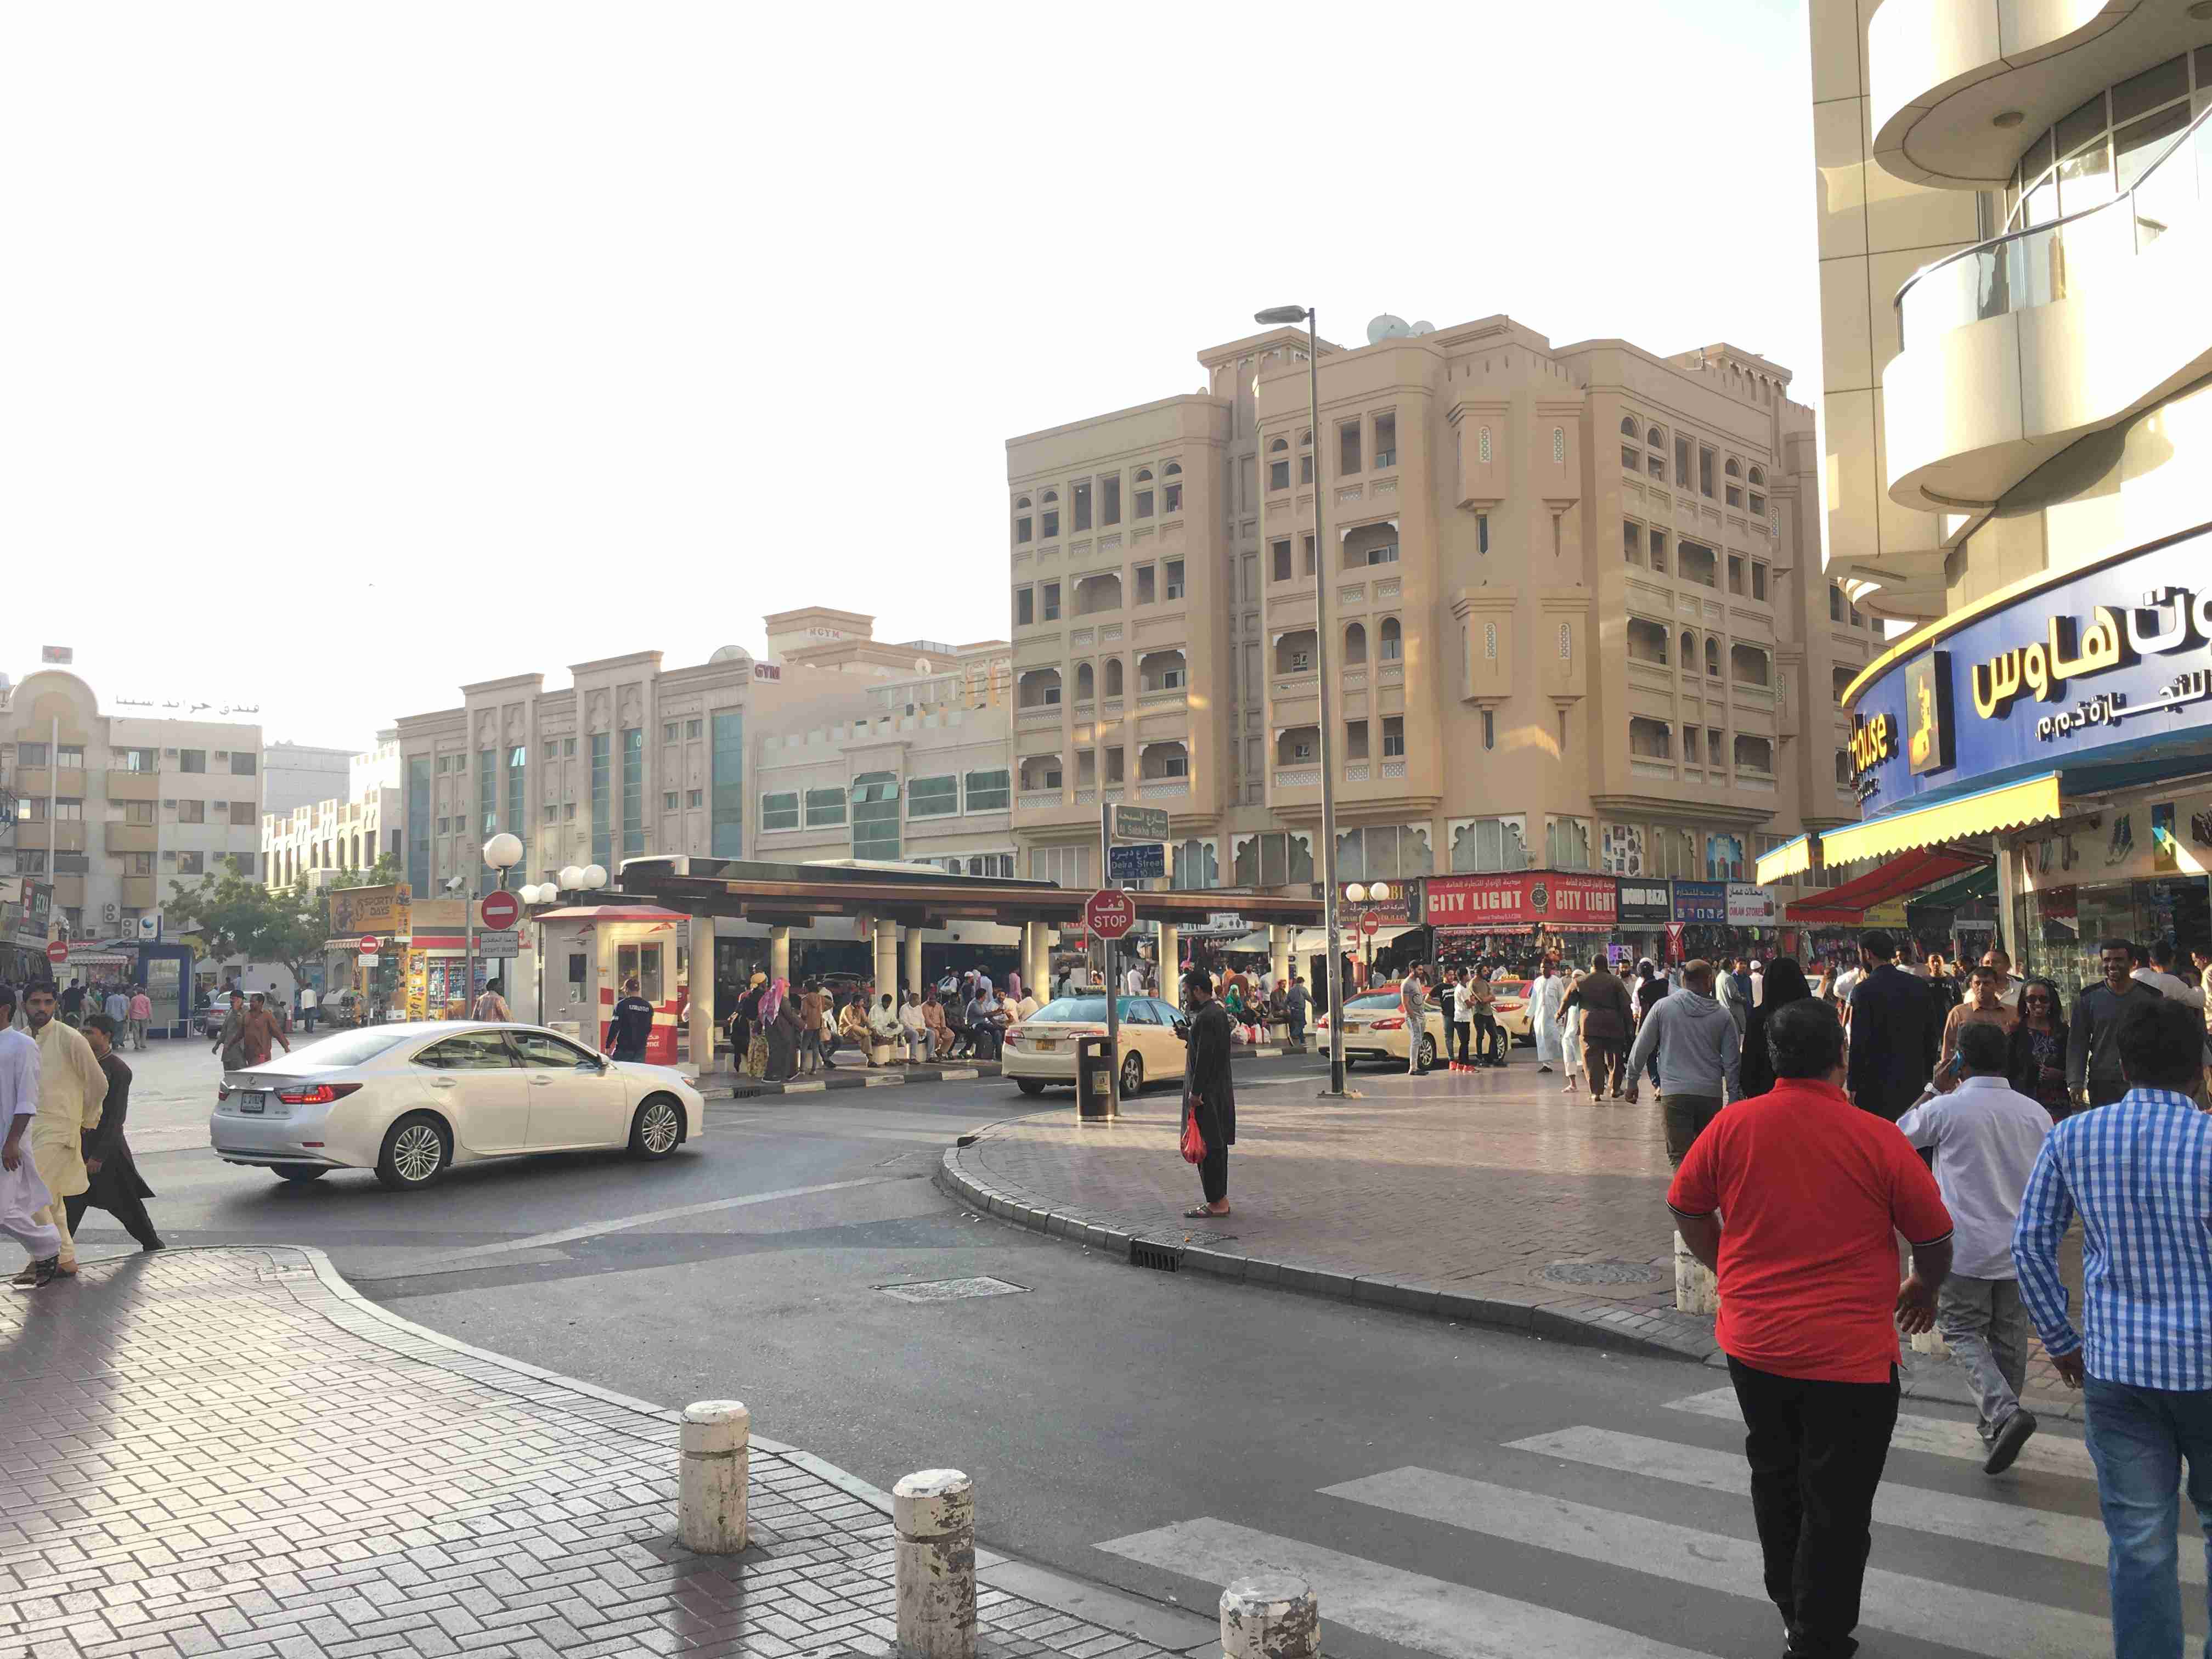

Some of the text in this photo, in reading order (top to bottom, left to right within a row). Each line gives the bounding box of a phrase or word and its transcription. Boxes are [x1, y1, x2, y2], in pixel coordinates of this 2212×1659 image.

[1971, 606, 2120, 720] هاوس
[755, 664, 781, 680] GYM
[1119, 824, 1125, 834] Al
[1152, 827, 1167, 838] Road
[1111, 859, 1163, 870] Deira Street
[361, 896, 394, 905] SPORTY
[1095, 895, 1124, 912] قف
[1429, 890, 1522, 912] CITY LIGHT
[1555, 890, 1616, 911] CITY LIGHT
[370, 906, 390, 916] DAYS
[1729, 907, 1764, 917] OMAN STORES
[1094, 915, 1126, 928] STOP
